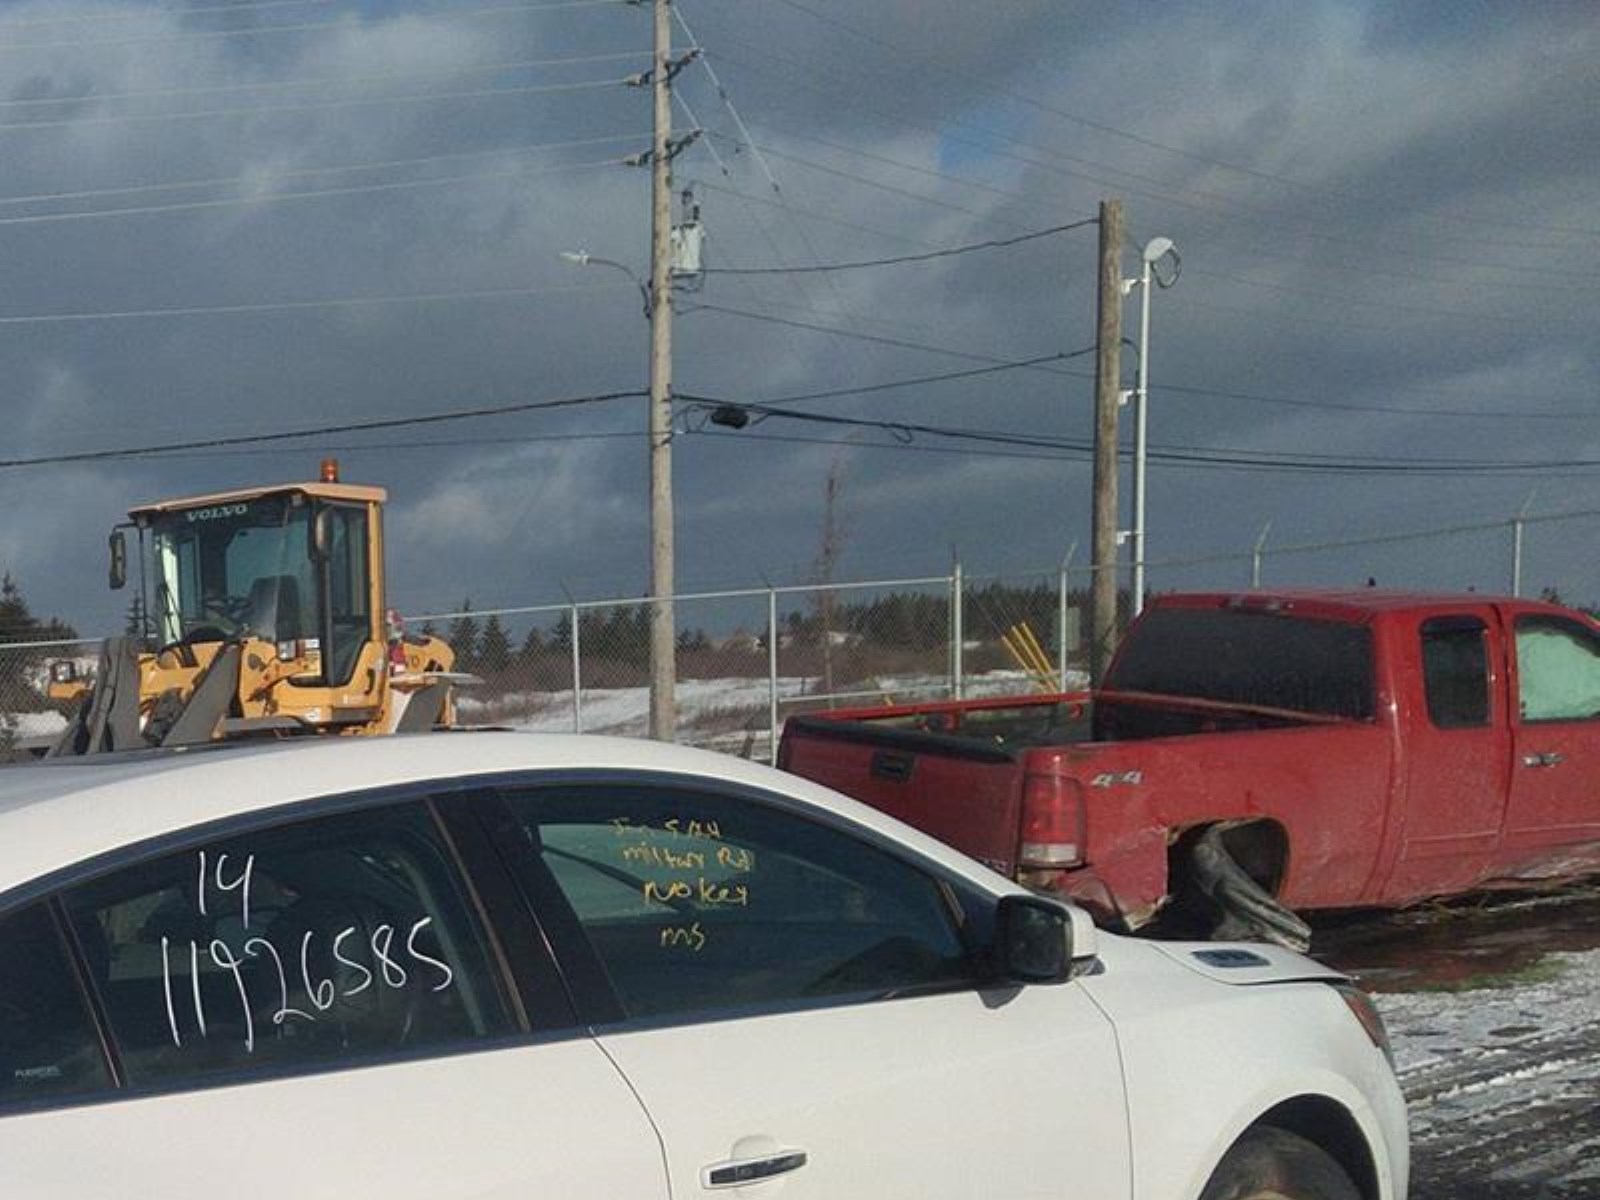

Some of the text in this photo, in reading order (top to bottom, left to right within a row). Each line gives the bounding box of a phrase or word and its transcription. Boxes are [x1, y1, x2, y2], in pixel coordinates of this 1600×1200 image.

[185, 504, 247, 521] VOLVO
[199, 850, 254, 930] 14
[162, 916, 453, 1052] 11926585
